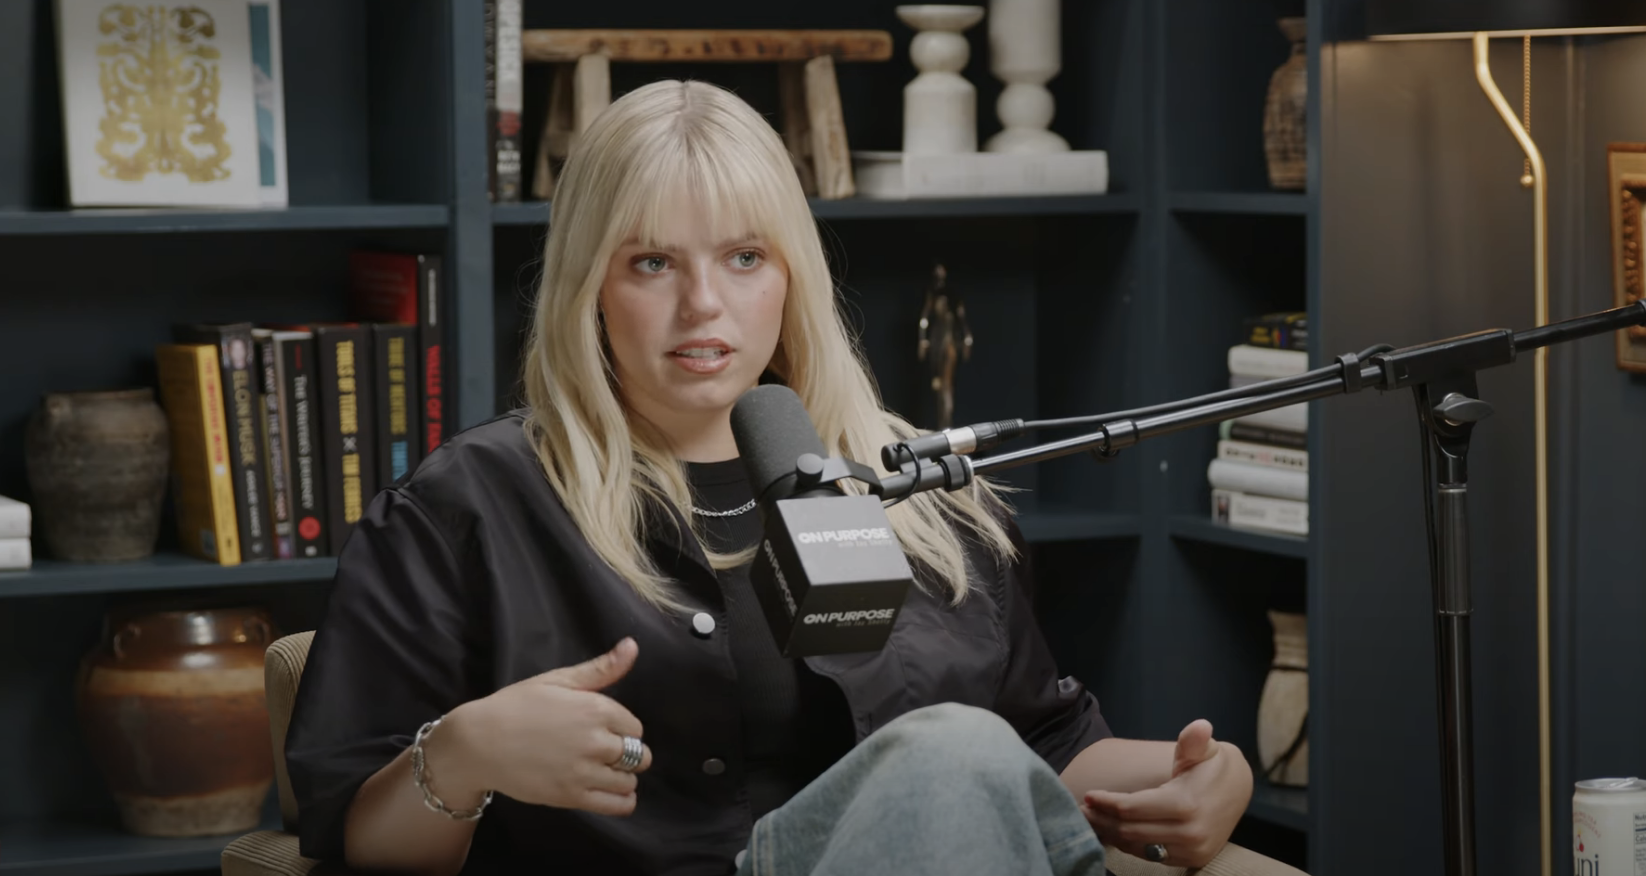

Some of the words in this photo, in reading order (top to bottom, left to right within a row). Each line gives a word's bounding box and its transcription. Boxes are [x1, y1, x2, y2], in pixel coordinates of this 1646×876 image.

[262, 342, 274, 364] THE
[336, 340, 356, 377] TOOLS
[265, 366, 277, 393] WAY
[388, 369, 405, 382] OF
[426, 344, 442, 396] WALLS
[233, 370, 251, 418] ELON
[294, 375, 308, 399] THE
[338, 377, 356, 392] OF
[266, 394, 279, 411] OF
[426, 398, 442, 420] OF
[269, 414, 281, 435] THE
[339, 394, 358, 435] TITANS
[237, 418, 257, 467] MUSK
[342, 453, 360, 475] TIM
[298, 456, 315, 510] JOURNEY
[798, 532, 824, 544] ON
[824, 527, 890, 543] PURPOSE
[764, 539, 775, 562] ON
[772, 556, 798, 617] PURPOSE
[803, 613, 828, 625] ON
[828, 608, 895, 622] PURPOSE
